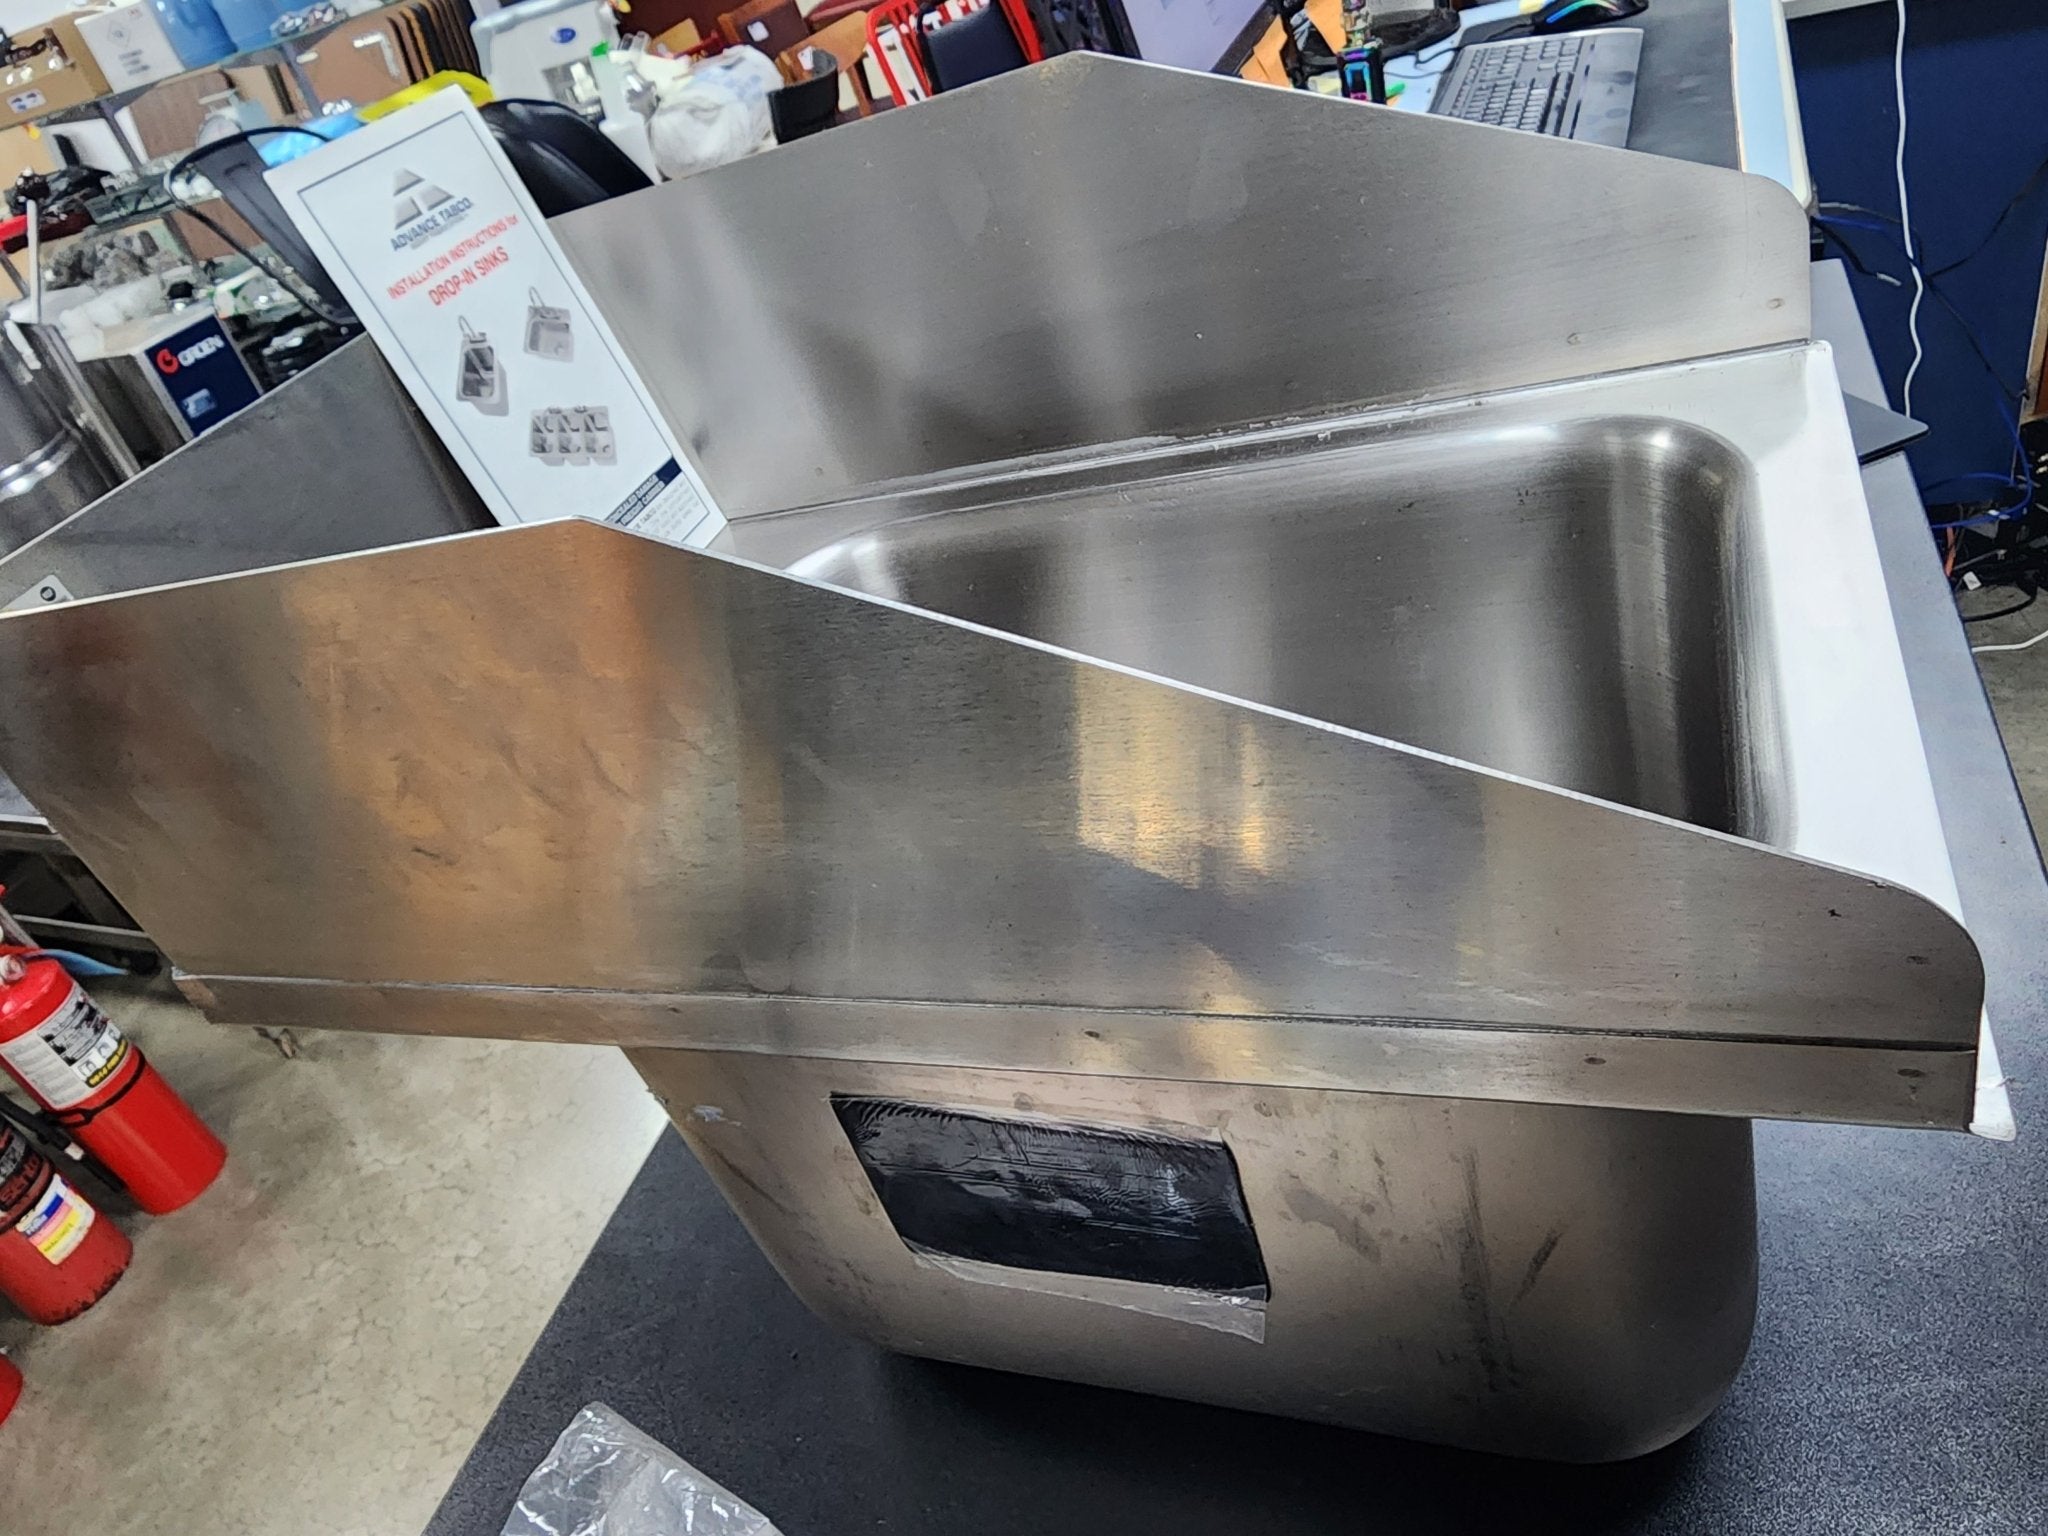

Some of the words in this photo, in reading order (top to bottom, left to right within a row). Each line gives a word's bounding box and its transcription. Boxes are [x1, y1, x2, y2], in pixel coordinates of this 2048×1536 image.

[387, 254, 451, 299] INSTALLATION
[448, 219, 507, 261] INSTRUCTIONS
[390, 215, 441, 251] ADVANCE
[428, 266, 478, 306] DROP-IN
[474, 246, 509, 276] SINKS
